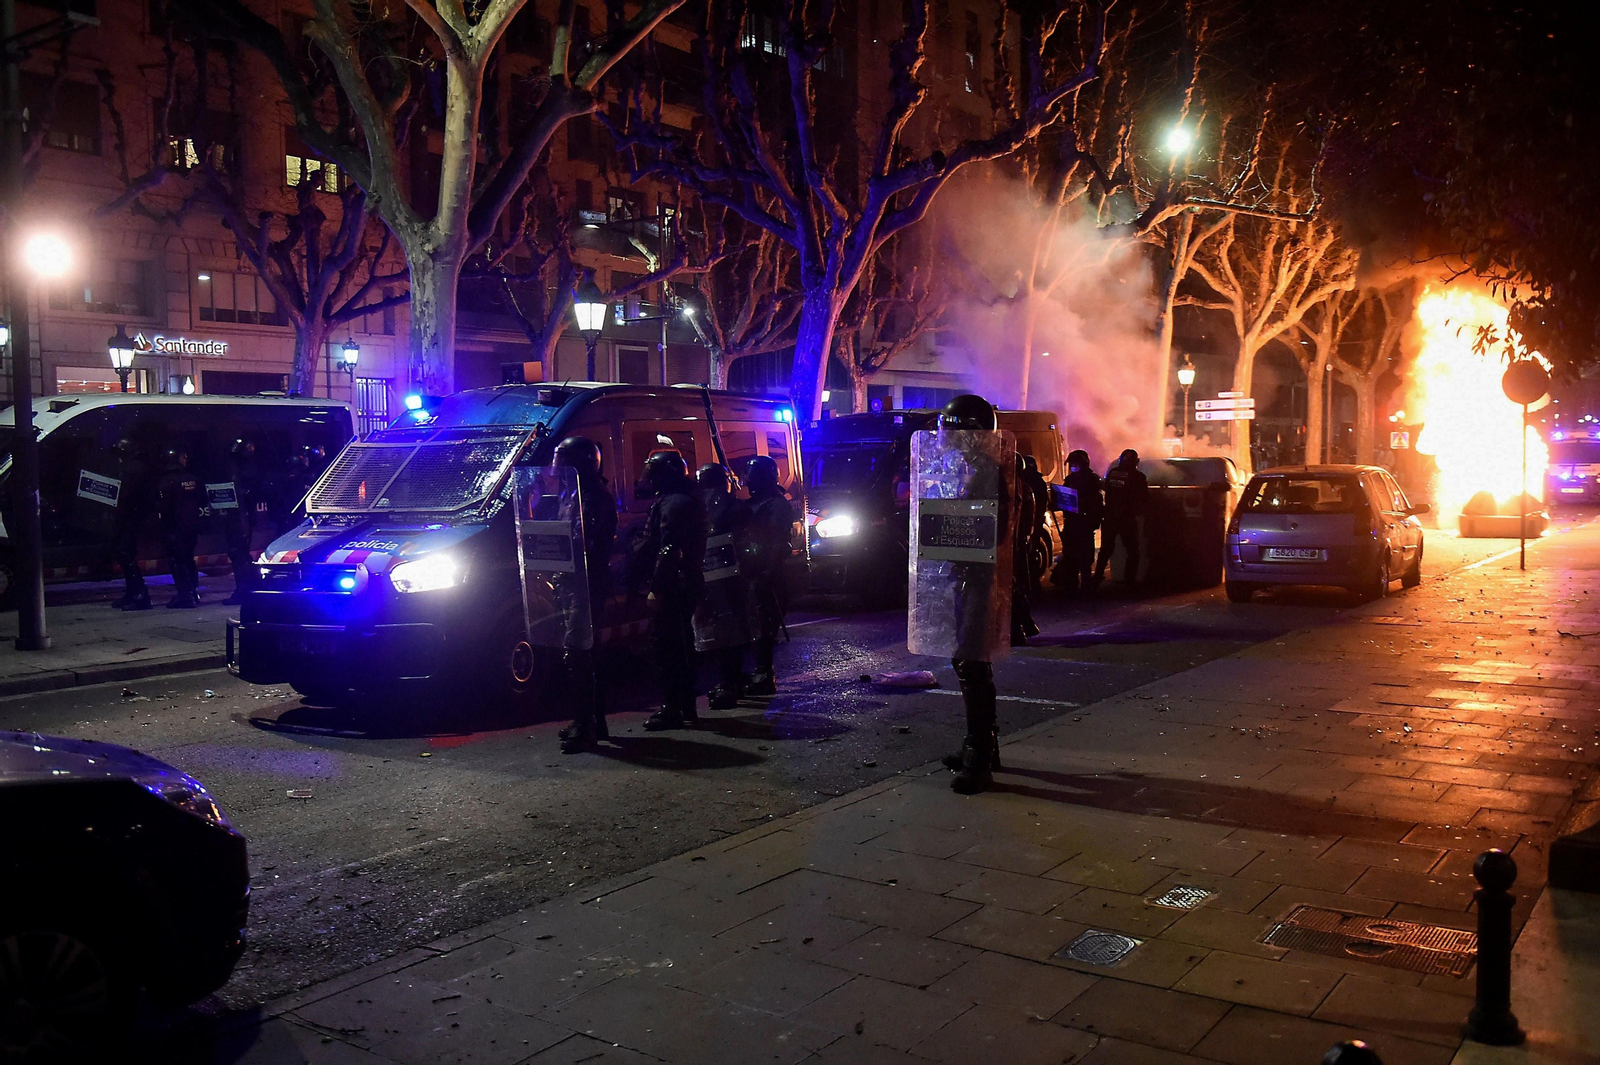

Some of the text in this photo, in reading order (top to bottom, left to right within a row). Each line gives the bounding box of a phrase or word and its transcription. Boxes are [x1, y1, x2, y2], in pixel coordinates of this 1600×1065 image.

[155, 336, 228, 355] Santander
[940, 525, 977, 536] Mossos
[342, 539, 399, 550] policia
[1276, 548, 1296, 557] 5820
